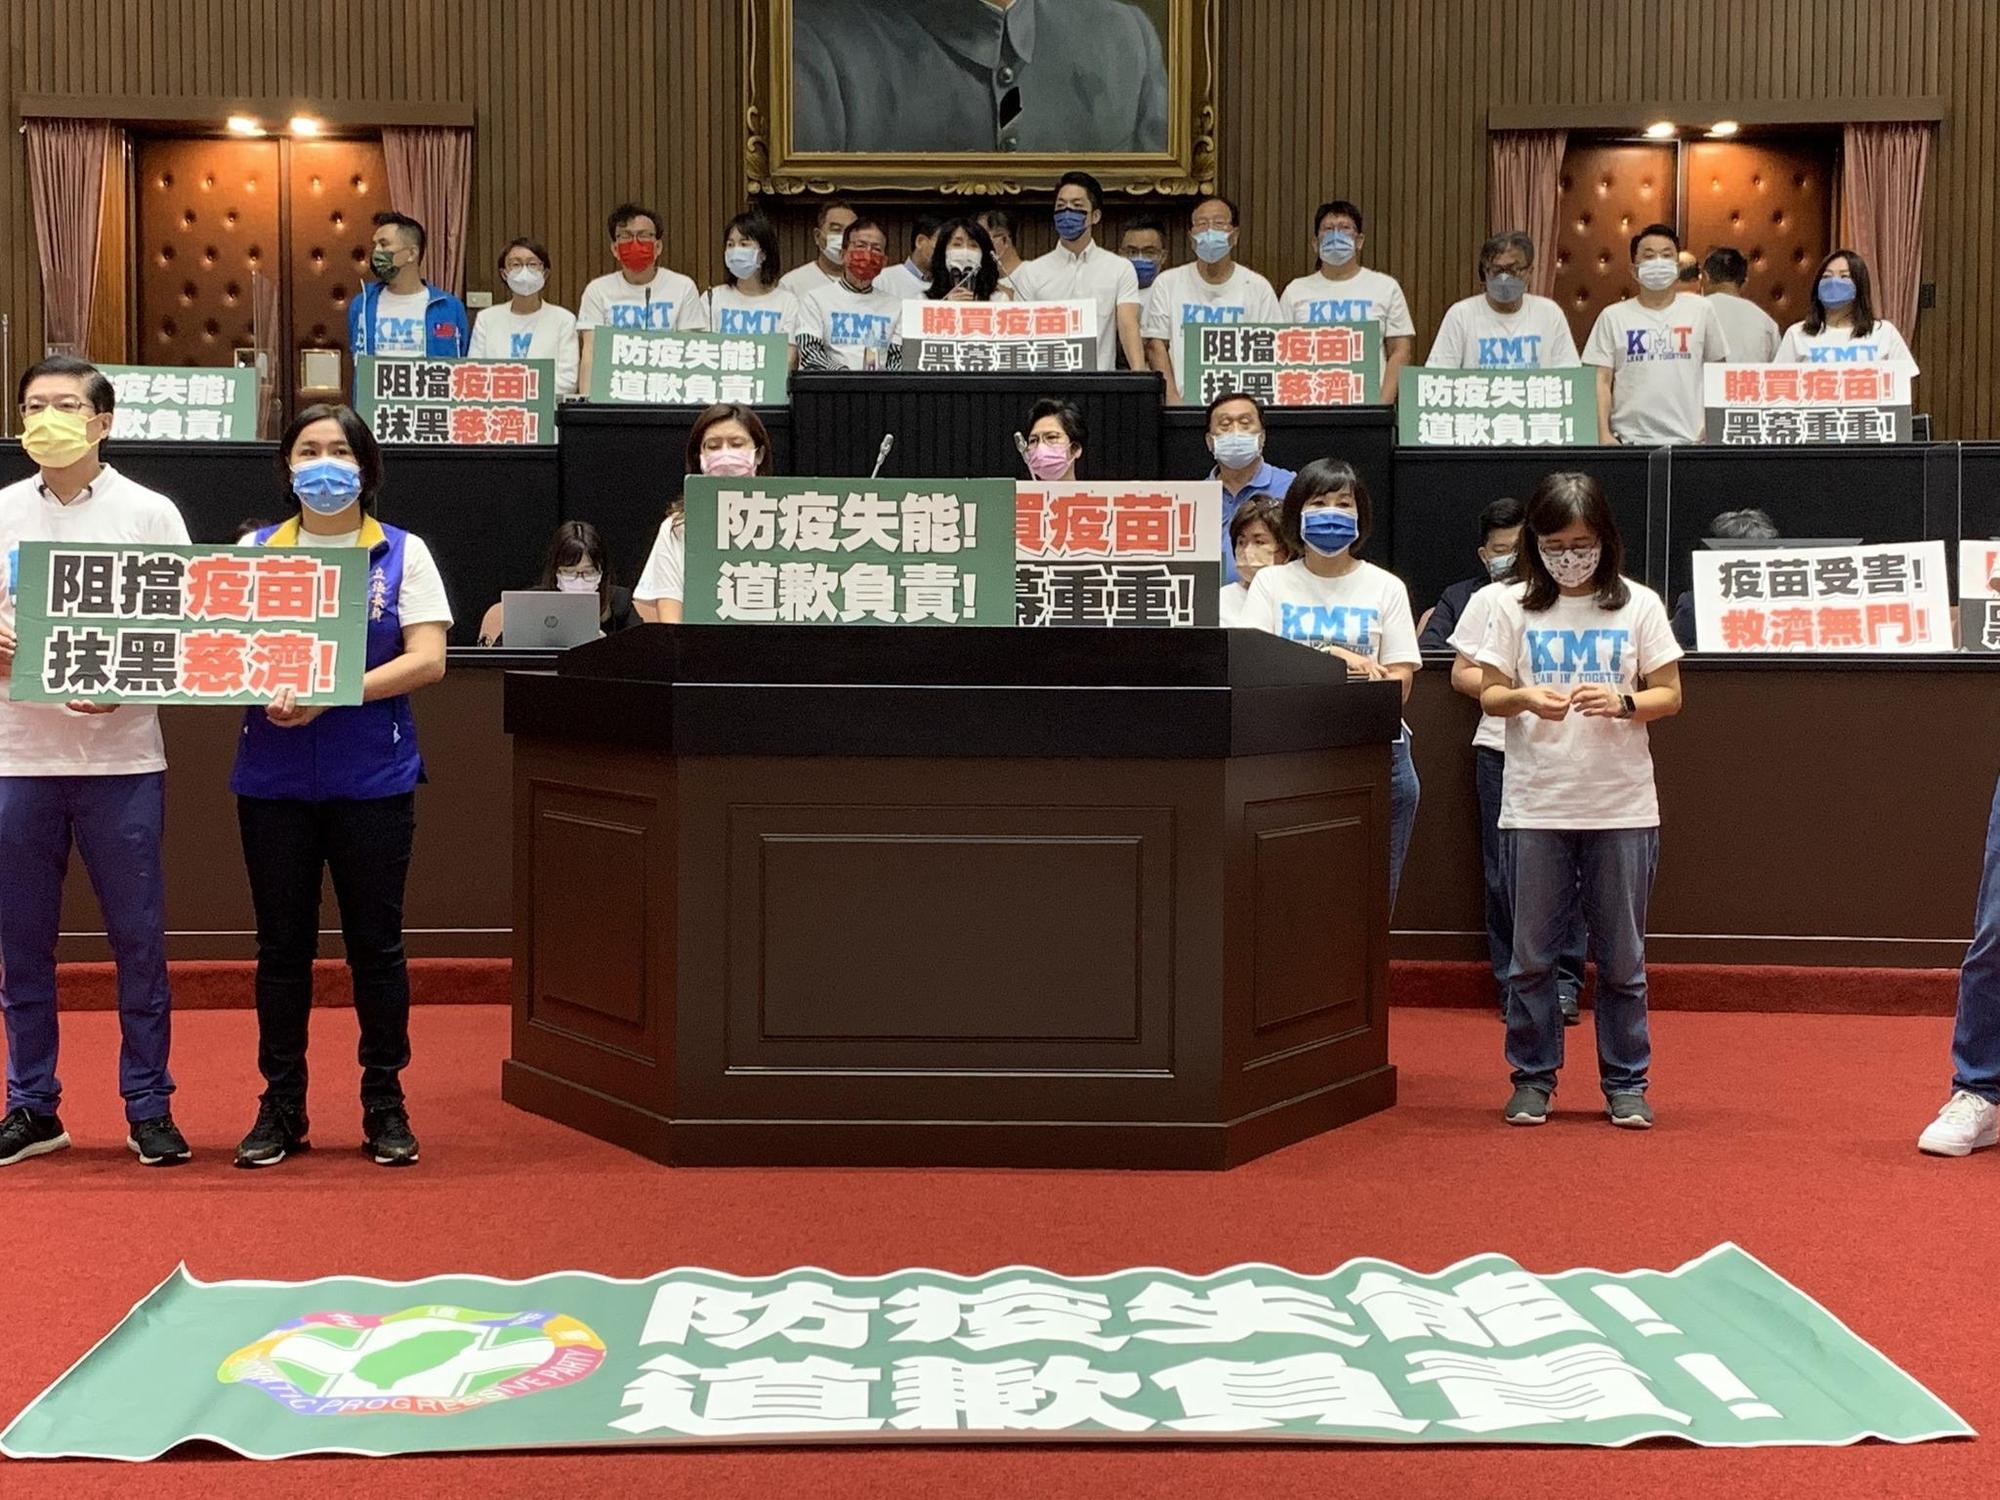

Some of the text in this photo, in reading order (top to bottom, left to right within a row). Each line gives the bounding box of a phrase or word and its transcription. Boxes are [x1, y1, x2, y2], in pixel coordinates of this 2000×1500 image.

[612, 302, 674, 329] KMT
[720, 308, 782, 334] KMT
[831, 312, 891, 340] KMT
[922, 305, 1082, 336] 購買疫苗!
[1182, 304, 1244, 324] KMT
[1309, 300, 1372, 322] KMT
[377, 317, 424, 343] KM
[1201, 326, 1364, 366] 阻擋疫苗!
[1626, 327, 1692, 355] KMT
[612, 334, 766, 371] 防疫失能!
[918, 341, 1082, 371] 黑幕重重!
[1479, 335, 1541, 364] KMT
[1809, 344, 1878, 362] KMT
[101, 372, 236, 405] 疫失能!
[374, 361, 539, 401] 阻擋疫苗!
[610, 370, 765, 405] 道歉負責!
[1417, 374, 1574, 408] 防疫失能!
[1724, 369, 1894, 403] 購買疫苗!
[109, 408, 233, 440] 歉負責!
[374, 404, 539, 444] 抹黑慈濟!
[1418, 412, 1575, 446] 道歉負責!
[1722, 408, 1897, 444] 黑幕重重!
[716, 490, 978, 553] 防疫失能!
[47, 550, 341, 622] 阻擋疫苗!
[715, 561, 977, 624] 道歉負責!
[1718, 553, 1924, 600] 疫苗受害!
[1281, 602, 1378, 645] KMT
[1720, 602, 1928, 650] 救濟無門!
[41, 625, 338, 697] 抹黑慈濟!
[1526, 629, 1629, 673] KMT
[638, 1271, 1684, 1352] 防疫失能!
[607, 1343, 1785, 1434] 道歉負責!
